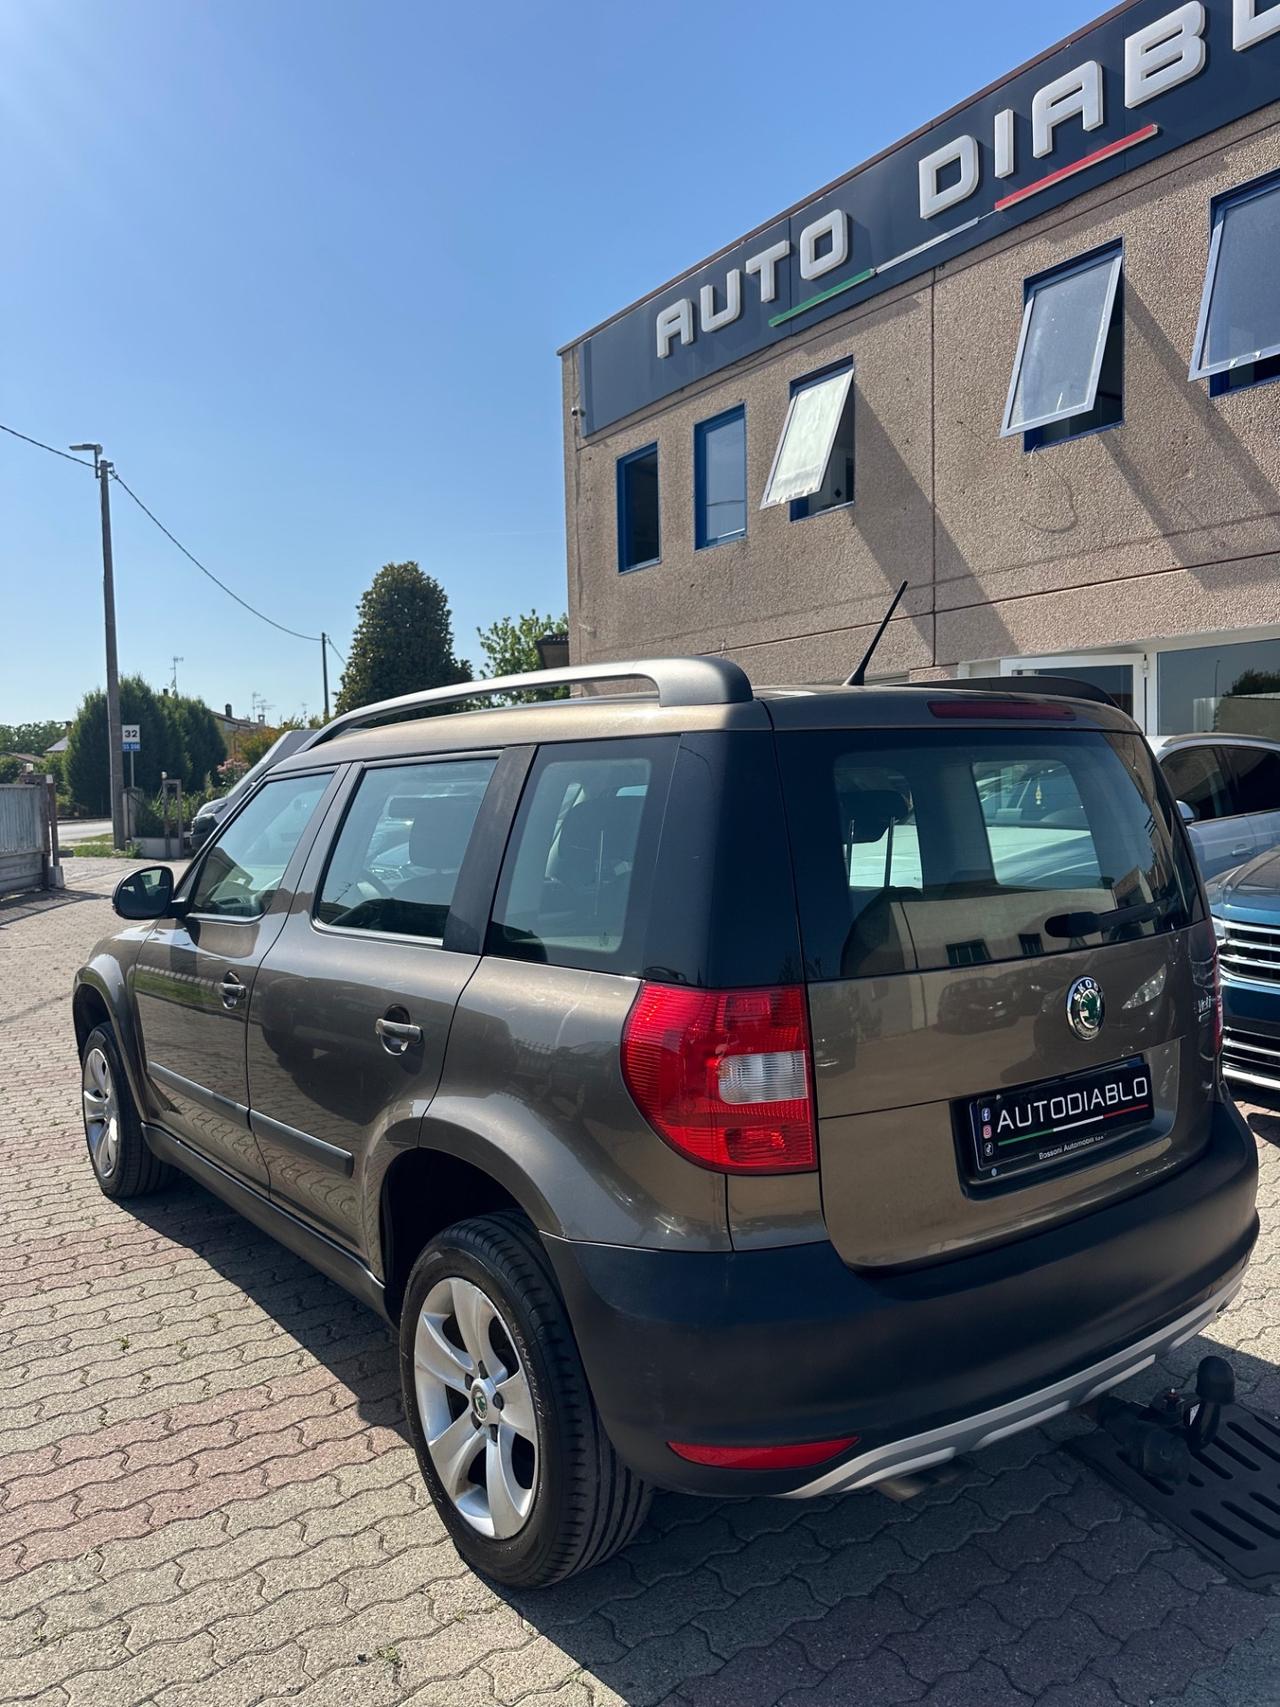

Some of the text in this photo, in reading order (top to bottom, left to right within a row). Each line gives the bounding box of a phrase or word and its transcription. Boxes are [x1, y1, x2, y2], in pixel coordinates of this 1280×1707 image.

[655, 208, 849, 360] AUTO
[124, 729, 138, 738] 32
[996, 1076, 1149, 1134] AUTODIABLO
